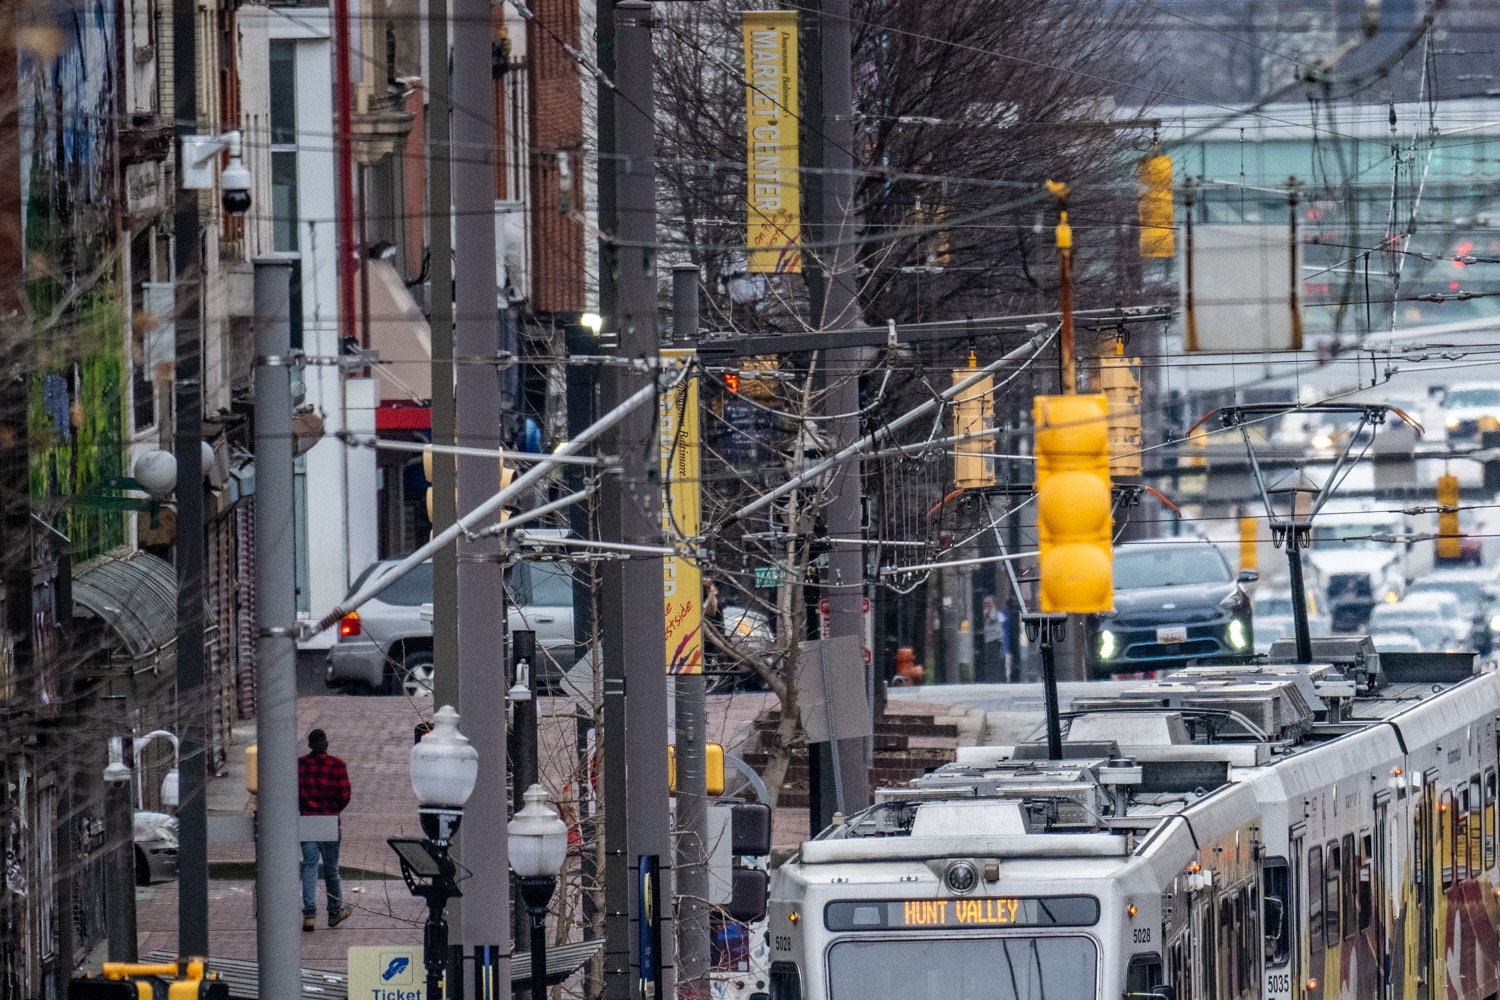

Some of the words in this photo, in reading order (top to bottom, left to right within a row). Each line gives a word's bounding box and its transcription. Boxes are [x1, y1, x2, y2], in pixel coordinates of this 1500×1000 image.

[751, 30, 779, 122] MARKET
[752, 125, 782, 212] CENTER
[904, 900, 947, 925] HUNT
[956, 899, 1018, 924] VALLEY
[775, 936, 792, 951] 5028
[1133, 928, 1151, 944] 5028
[1267, 974, 1290, 994] 5035
